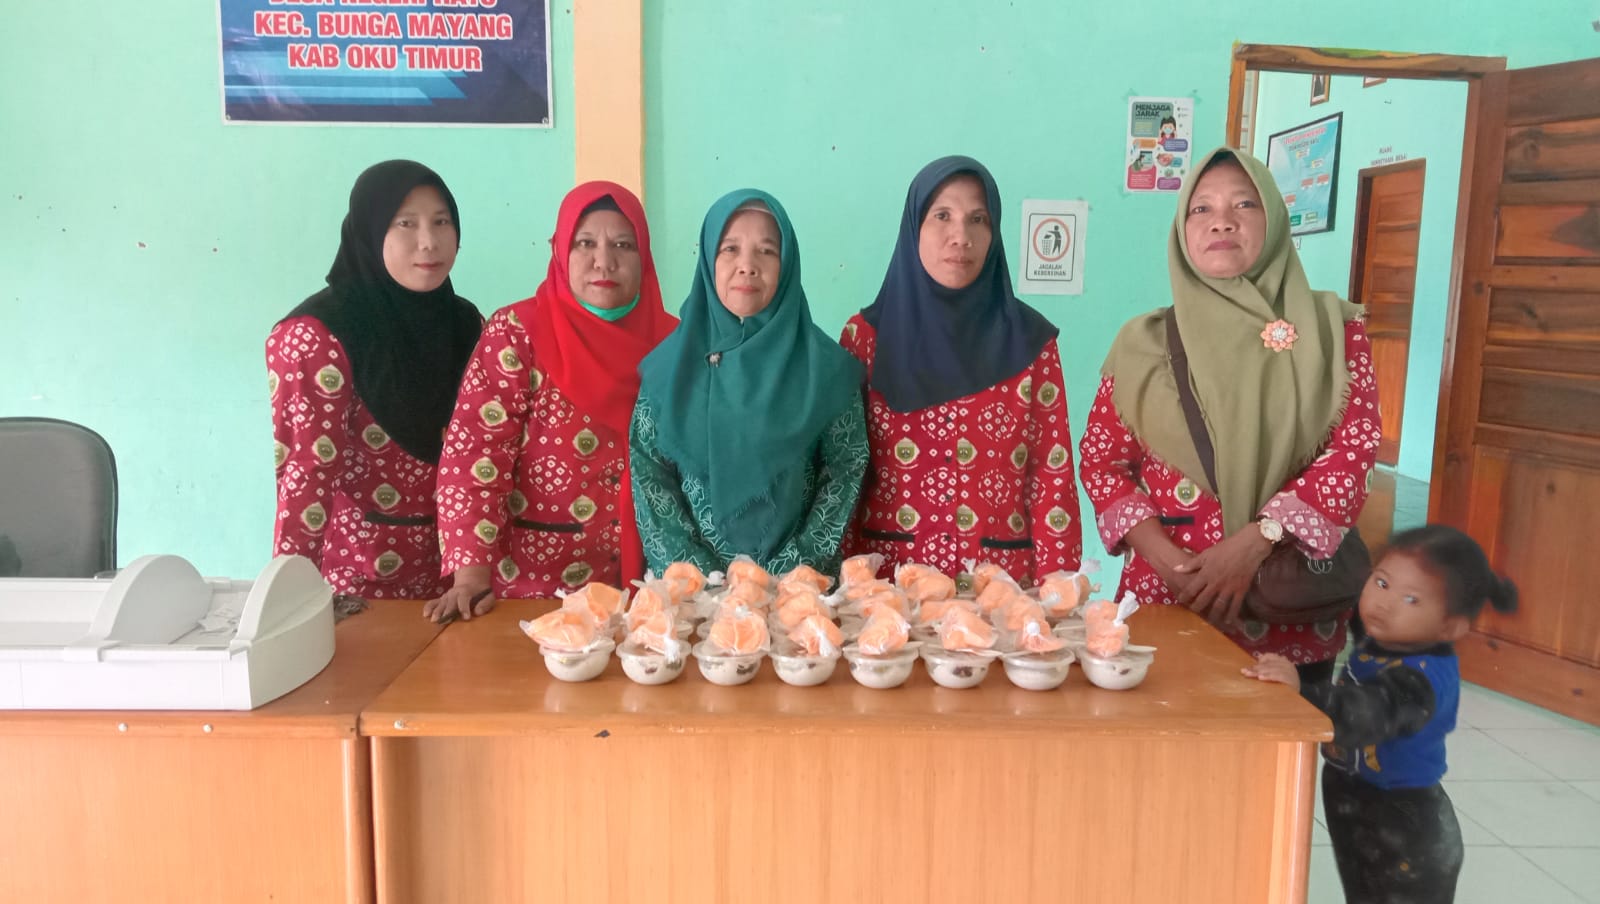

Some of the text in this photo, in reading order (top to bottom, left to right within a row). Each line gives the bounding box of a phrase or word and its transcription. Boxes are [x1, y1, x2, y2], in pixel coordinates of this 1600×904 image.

[255, 12, 512, 39] KEC. BUNGA MAYANG
[288, 44, 482, 71] KAB OKU TIMUR
[1135, 103, 1171, 111] MENJAGA
